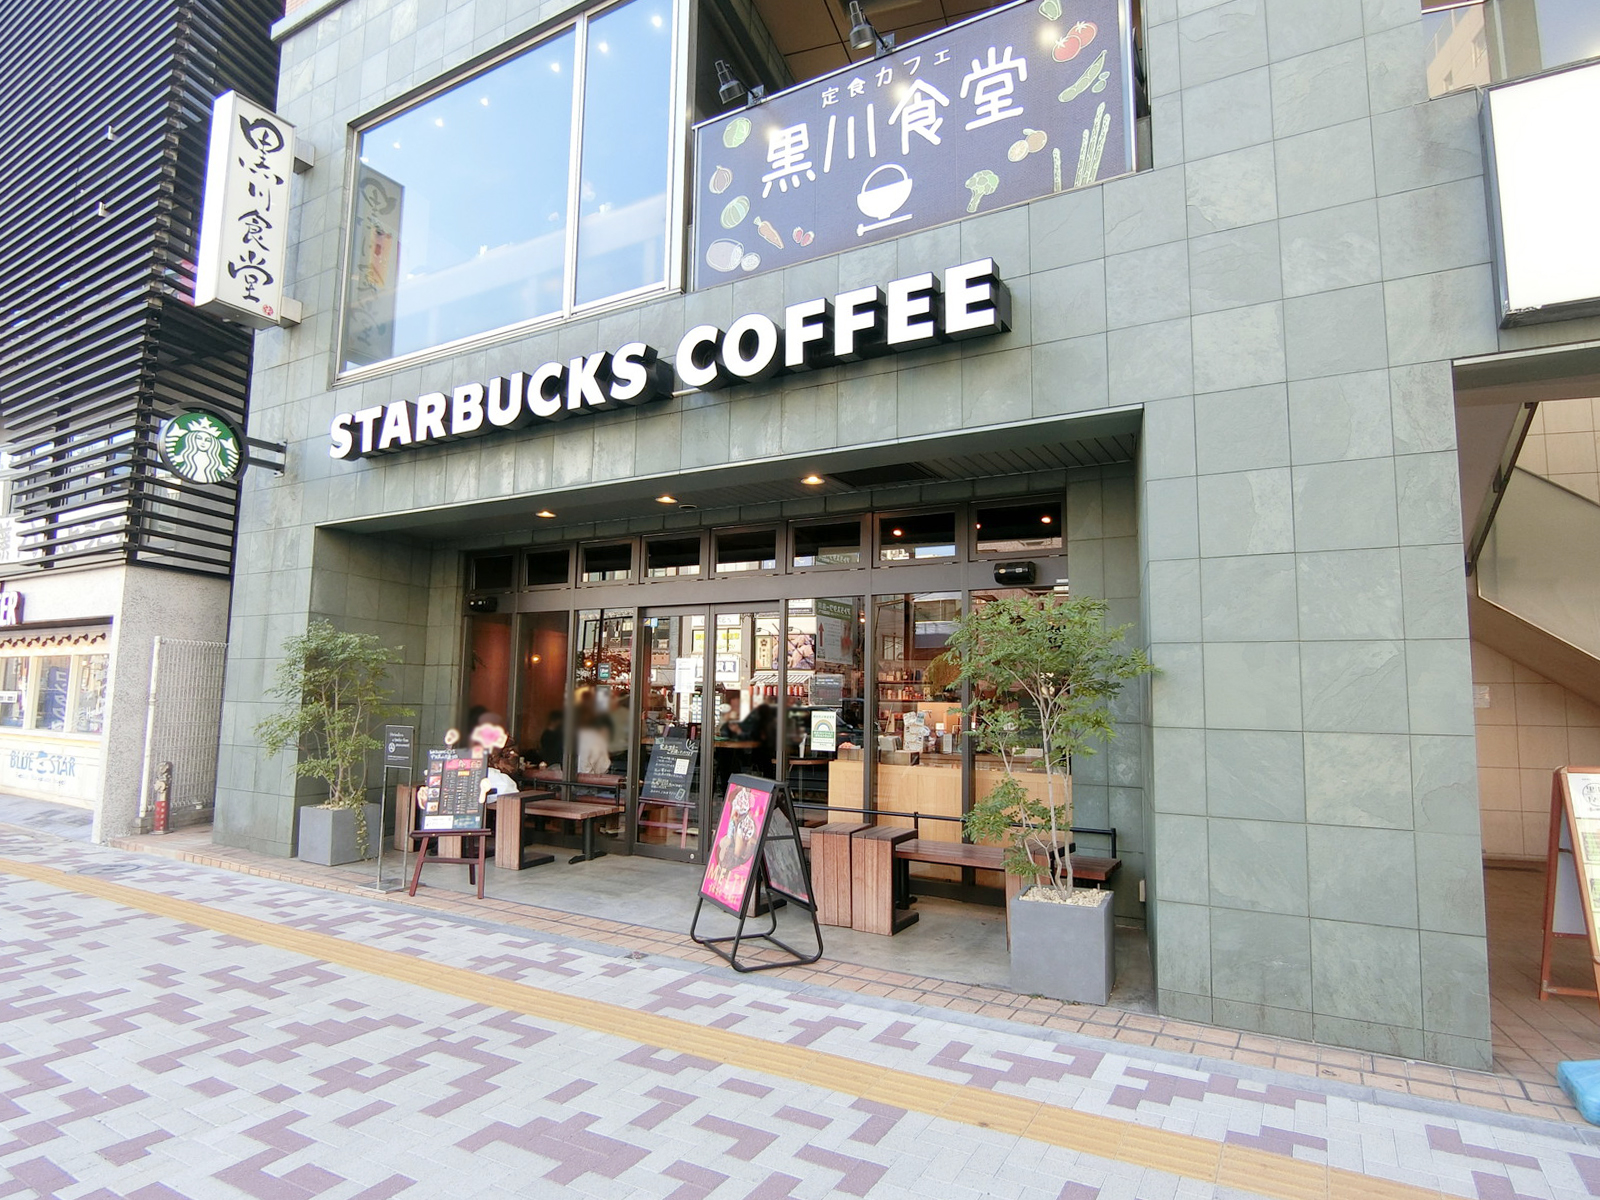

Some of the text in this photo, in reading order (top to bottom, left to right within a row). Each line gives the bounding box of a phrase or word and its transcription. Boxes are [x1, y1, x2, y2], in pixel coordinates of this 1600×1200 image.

[761, 46, 1028, 199] 黒川食堂
[821, 48, 954, 108] 定食カフェ
[228, 114, 285, 303] 黒川食堂
[328, 257, 998, 460] STARBUCKS COFFEE
[10, 750, 77, 777] BLUE STAR
[707, 863, 748, 895] MELTY
